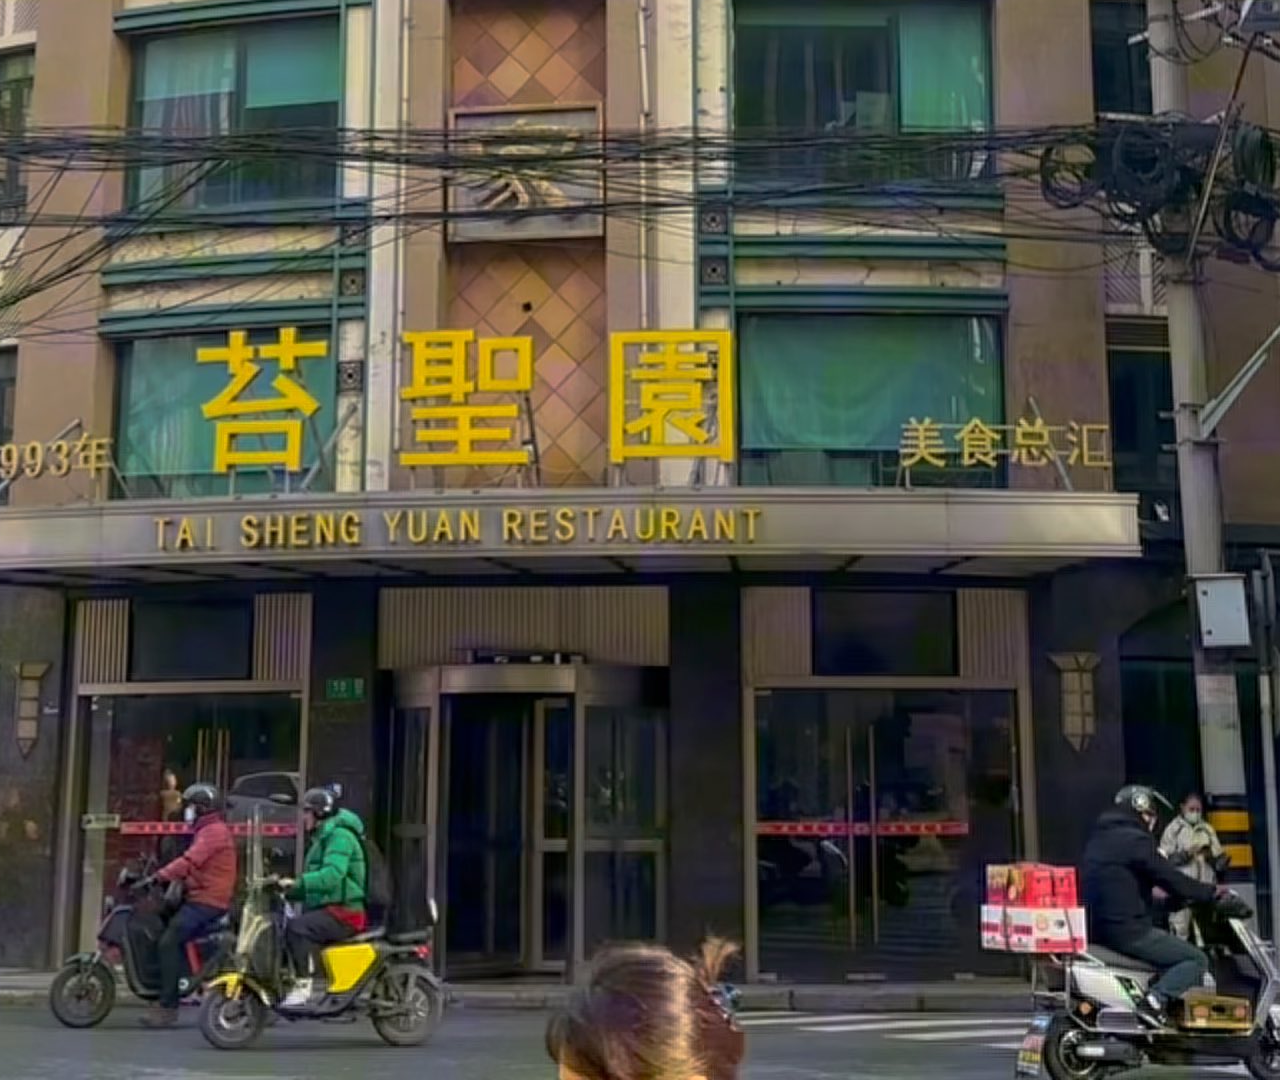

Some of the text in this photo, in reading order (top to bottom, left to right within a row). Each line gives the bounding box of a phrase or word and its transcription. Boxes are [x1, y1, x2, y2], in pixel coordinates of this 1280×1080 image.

[197, 327, 734, 473] 苔聖園
[899, 417, 1113, 468] 美食总汇
[154, 508, 761, 550] TAI SHENG YUAN RESTAURANT
